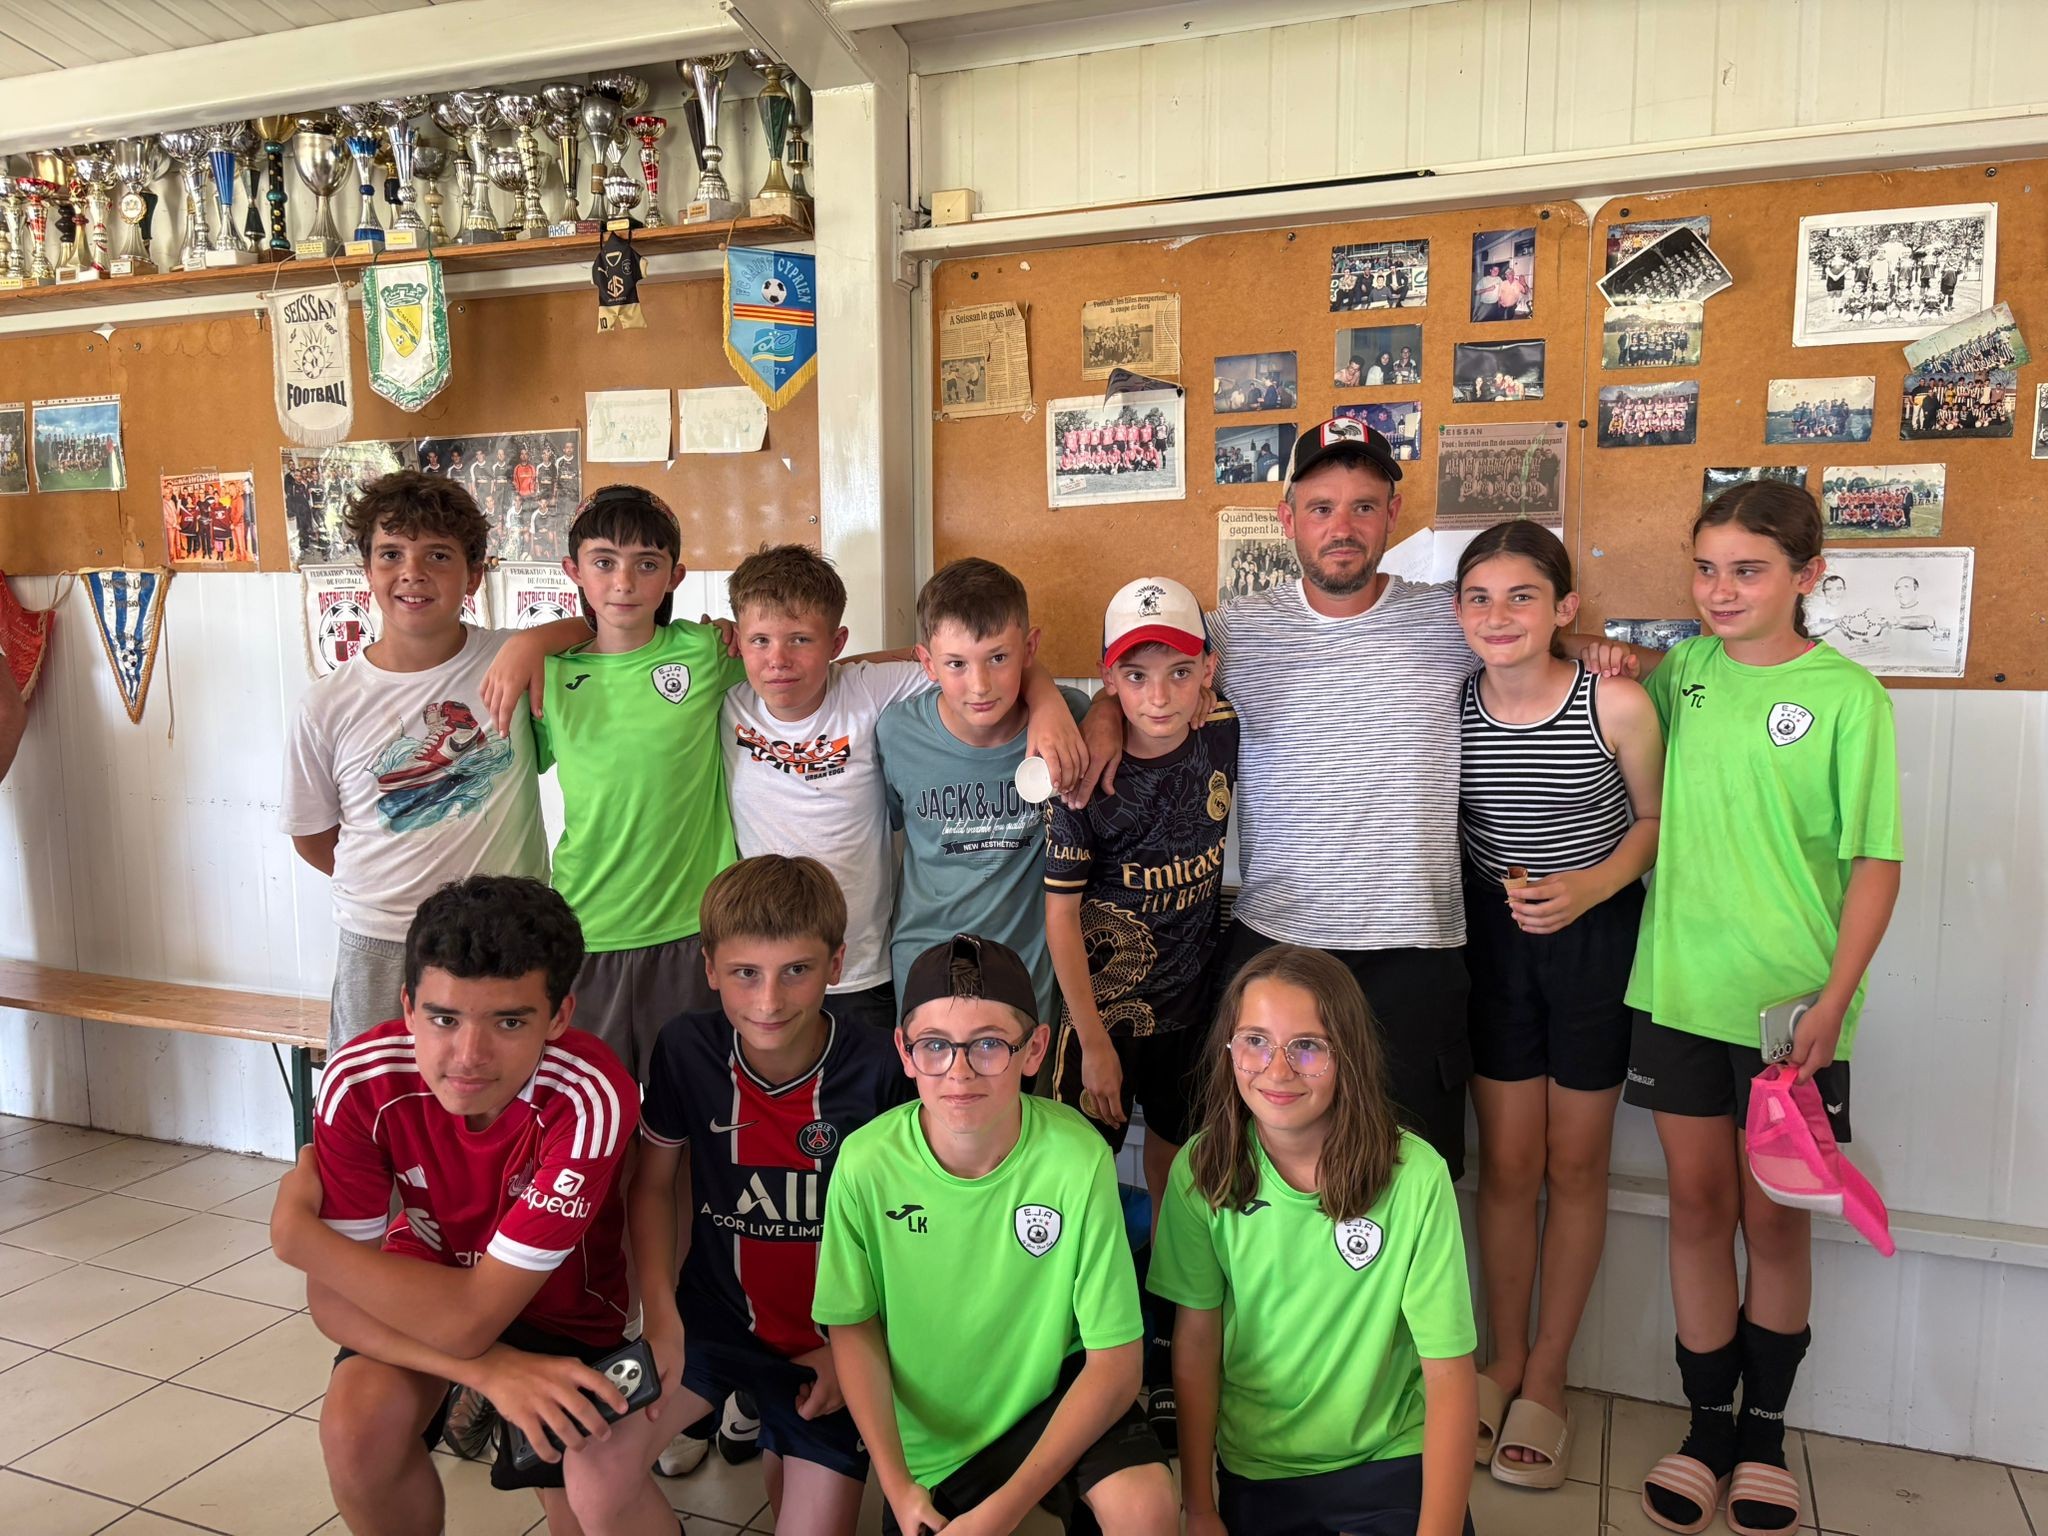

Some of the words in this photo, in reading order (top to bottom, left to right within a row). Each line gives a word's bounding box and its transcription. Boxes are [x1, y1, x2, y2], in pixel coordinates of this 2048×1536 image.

[777, 258, 812, 304] CYPRIEN
[284, 294, 337, 323] SEISSAN
[950, 316, 955, 326] A
[956, 313, 981, 326] Seissan
[981, 310, 988, 320] le
[988, 309, 1004, 320] gros
[1005, 307, 1016, 318] lot
[287, 380, 347, 410] FOOTBALL
[1221, 512, 1253, 523] Quand
[1254, 513, 1267, 522] les
[1230, 526, 1268, 536] gagnent
[1270, 524, 1279, 534] la
[346, 568, 365, 577] FRANÇ
[318, 592, 346, 616] DISTRICT
[346, 591, 353, 600] DU
[354, 591, 372, 614] GERS
[517, 591, 545, 616] DISTRICT
[548, 592, 556, 602] DU
[558, 592, 577, 617] GERS
[1690, 694, 1705, 708] TC
[805, 772, 828, 781] URBAN
[829, 767, 845, 776] EDGE
[963, 842, 979, 851] NEW
[980, 840, 1020, 849] AESTHETICS
[1142, 891, 1173, 913] FLY
[1176, 873, 1218, 912] BETTE
[806, 1124, 832, 1132] PARIS
[750, 1223, 785, 1237] LIVE
[789, 1224, 824, 1237] LIMI
[908, 1216, 928, 1234] LK
